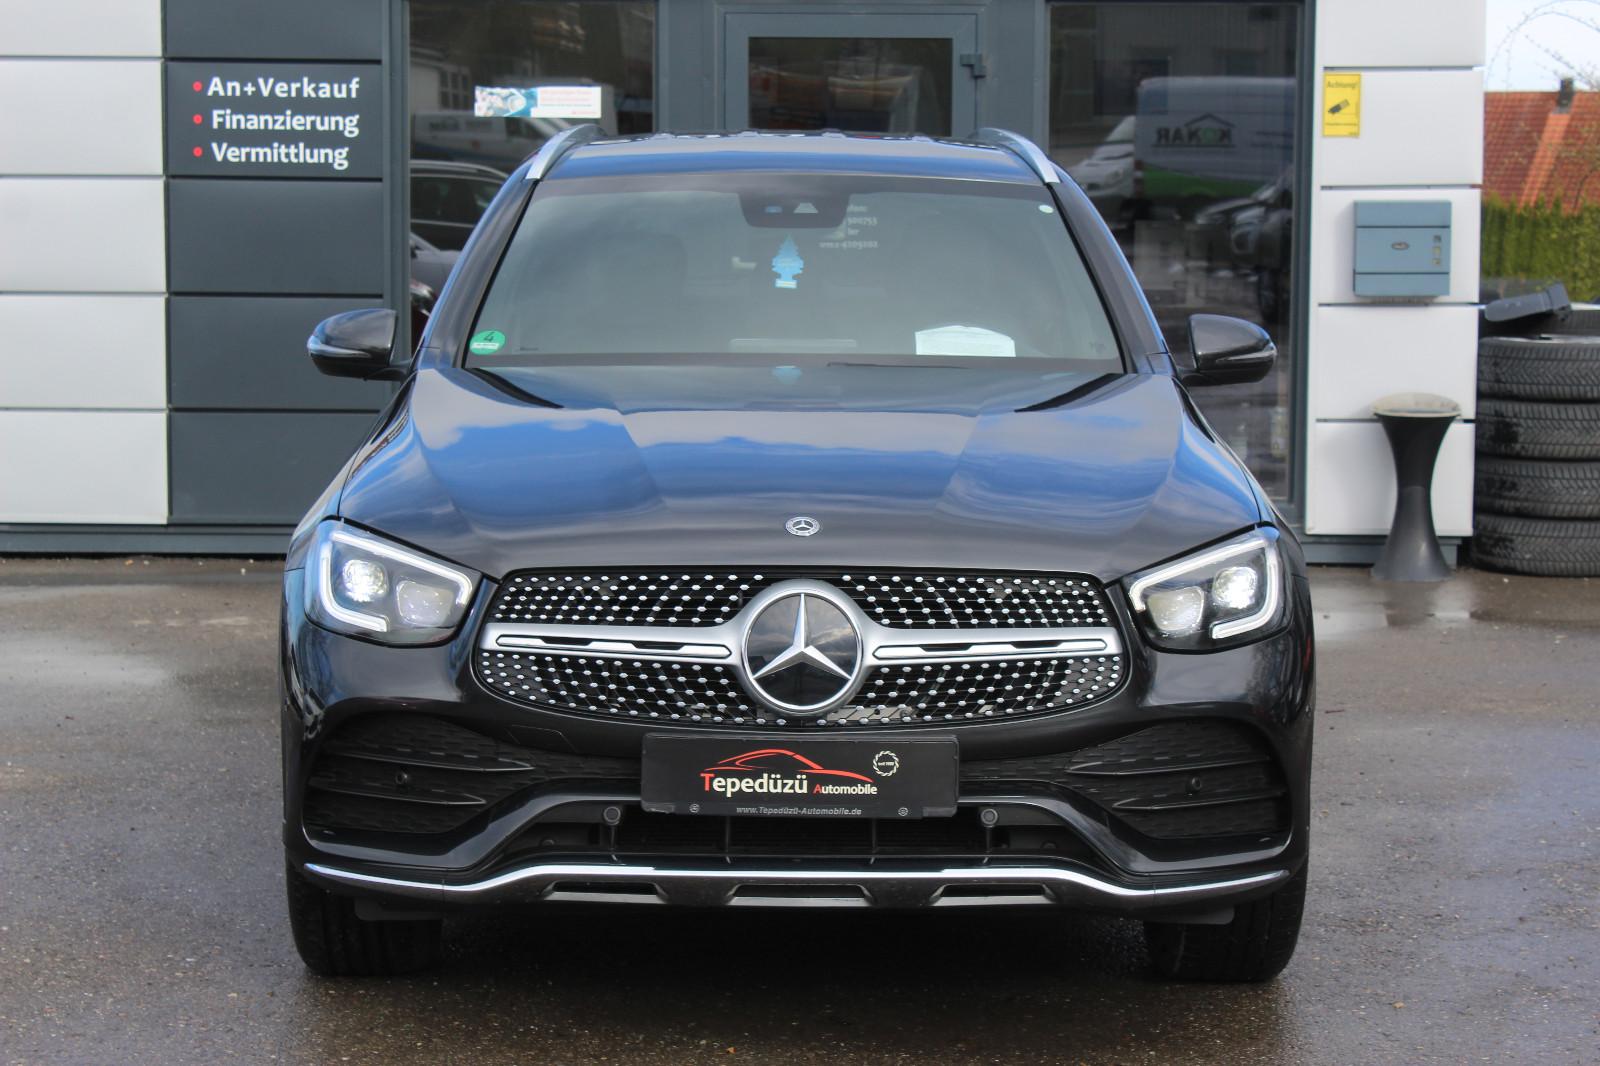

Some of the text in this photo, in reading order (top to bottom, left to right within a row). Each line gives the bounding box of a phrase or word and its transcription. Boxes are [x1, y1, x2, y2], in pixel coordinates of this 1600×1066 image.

[207, 76, 360, 99] An+Verkauf
[212, 108, 360, 138] Finanzierung
[211, 141, 350, 170] Vermittlung
[700, 772, 878, 798] Tepedüzü Automobile
[736, 805, 862, 816] www.Tepedüzü-Automobile.de
